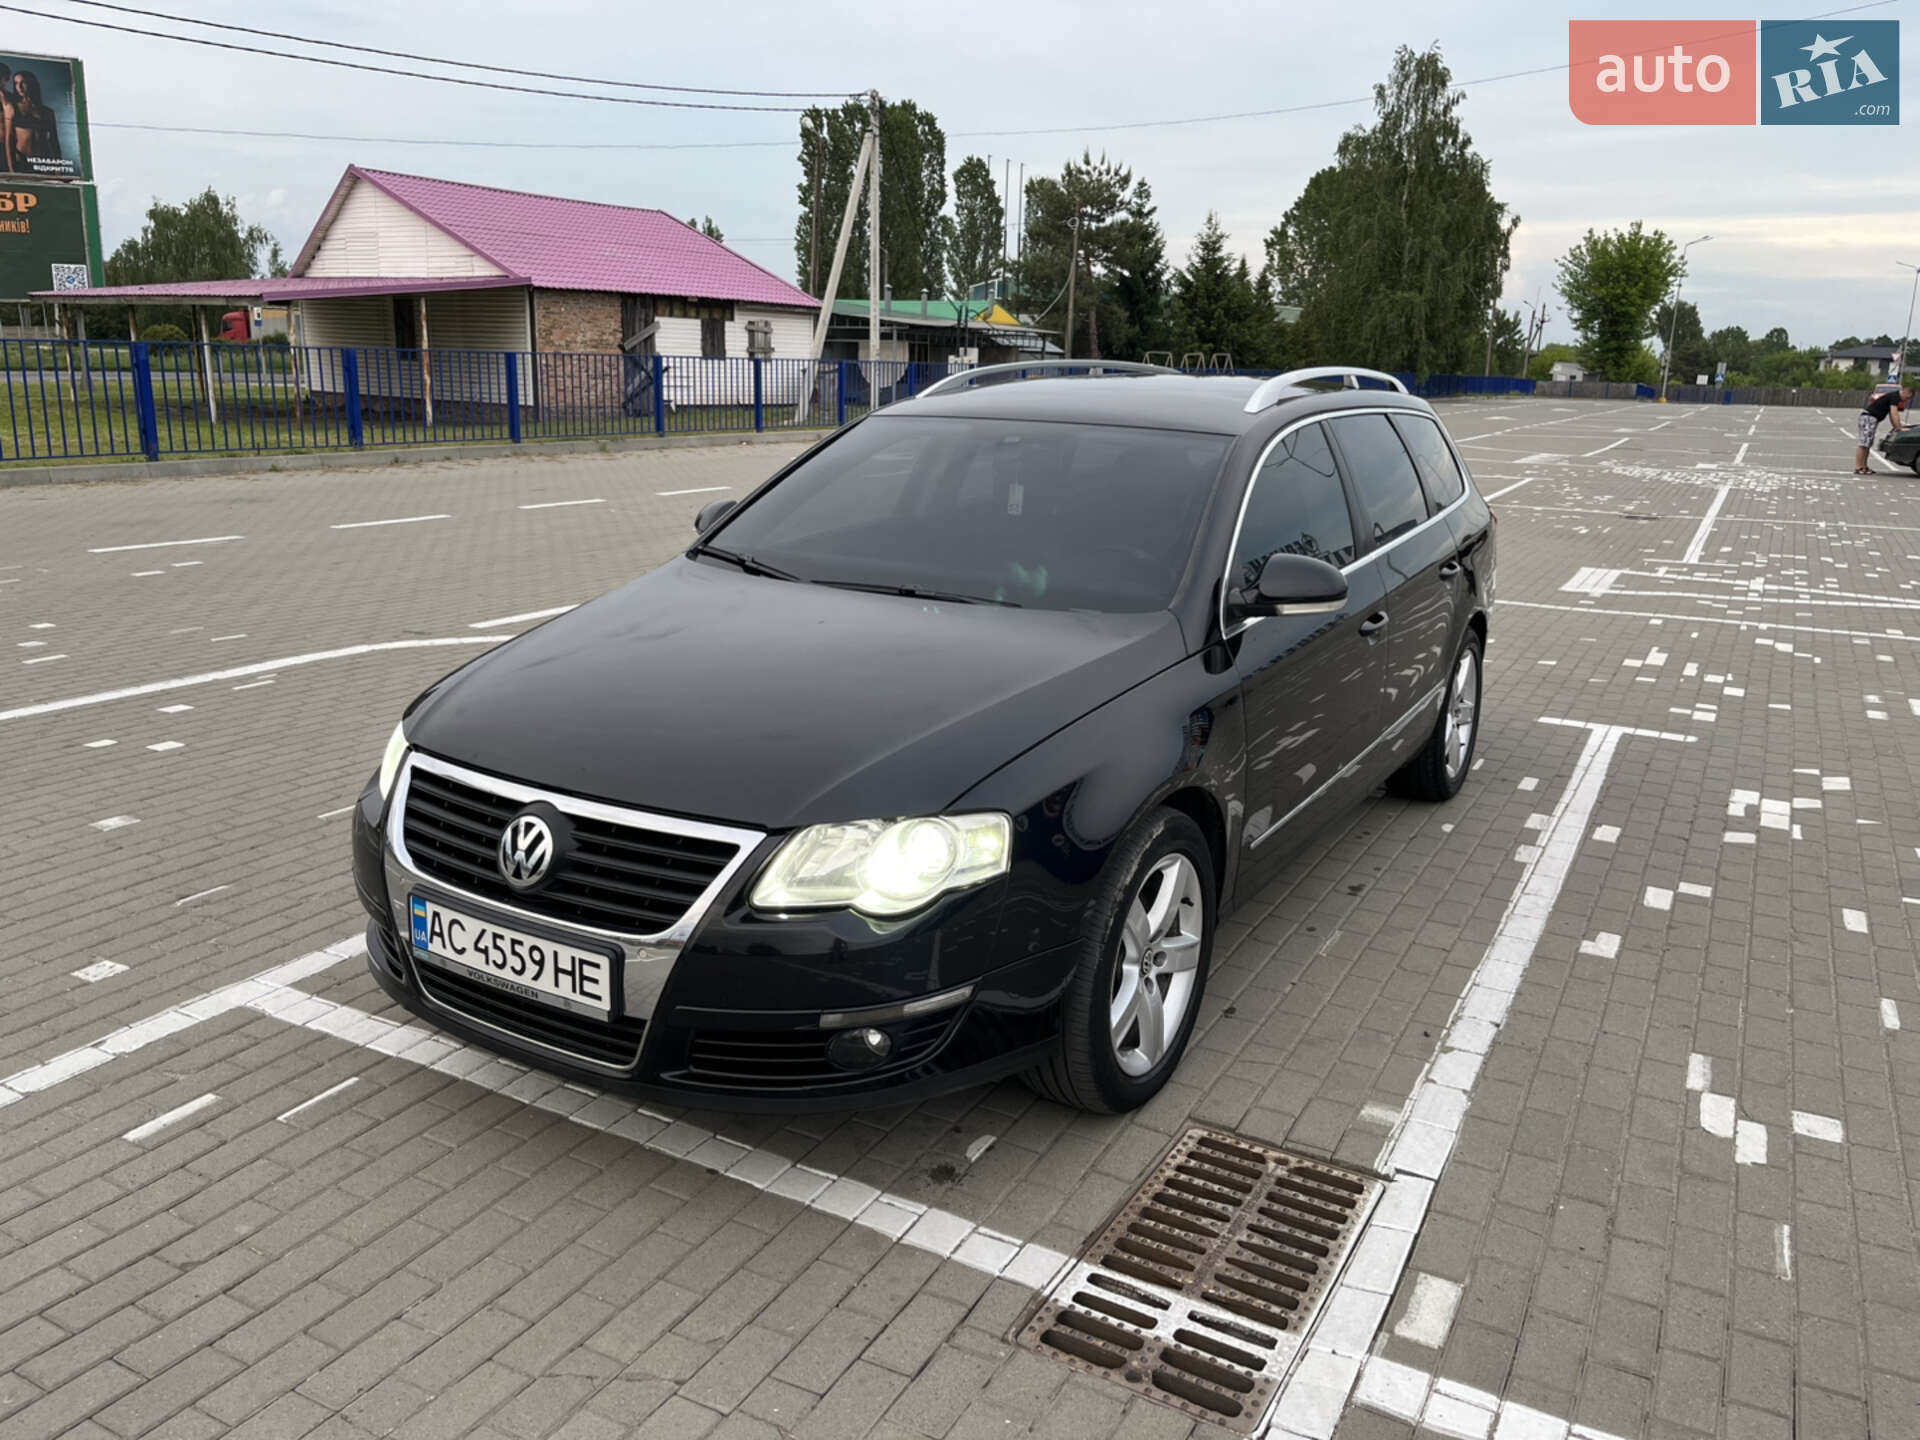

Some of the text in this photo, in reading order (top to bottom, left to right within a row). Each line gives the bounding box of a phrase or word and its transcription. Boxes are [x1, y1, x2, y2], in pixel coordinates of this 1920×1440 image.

[414, 928, 428, 942] UA
[430, 911, 603, 1002] AC 4559 HE
[466, 969, 539, 999] VOLKSWAGEN
